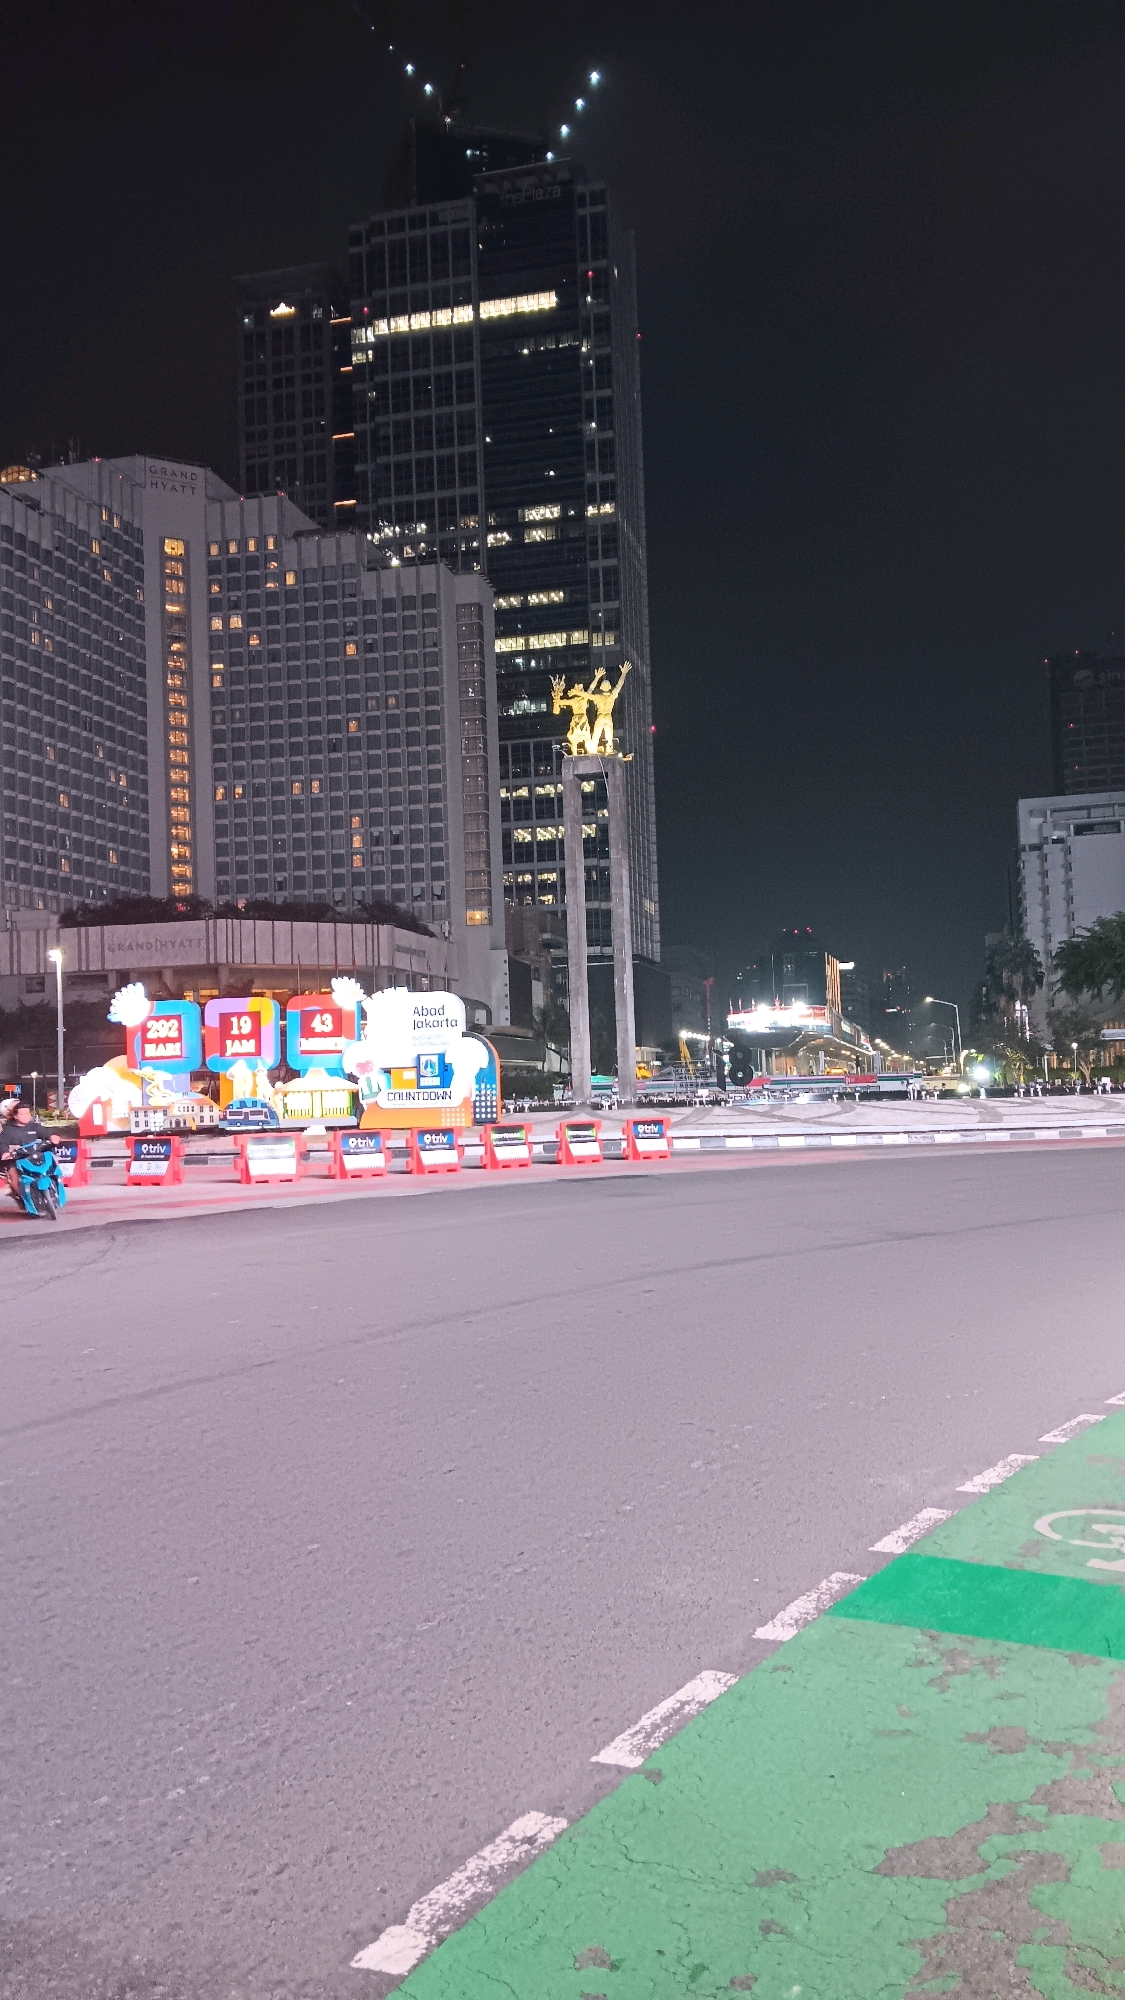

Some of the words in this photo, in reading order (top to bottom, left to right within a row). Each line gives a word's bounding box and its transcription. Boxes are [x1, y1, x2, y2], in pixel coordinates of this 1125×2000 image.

[149, 465, 198, 481] GRAND
[150, 479, 197, 495] HYATT
[107, 941, 153, 953] GRAND
[159, 938, 203, 950] HYATT
[412, 1004, 445, 1017] Abad
[146, 1018, 179, 1039] 292
[230, 1015, 252, 1035] 19
[310, 1013, 334, 1033] 43
[413, 1016, 458, 1031] Jakarta
[225, 1038, 256, 1057] JAM
[387, 1090, 452, 1101] COUNTDOWN
[356, 1137, 375, 1148] triv
[431, 1133, 448, 1144] triv
[148, 1142, 167, 1154] triv
